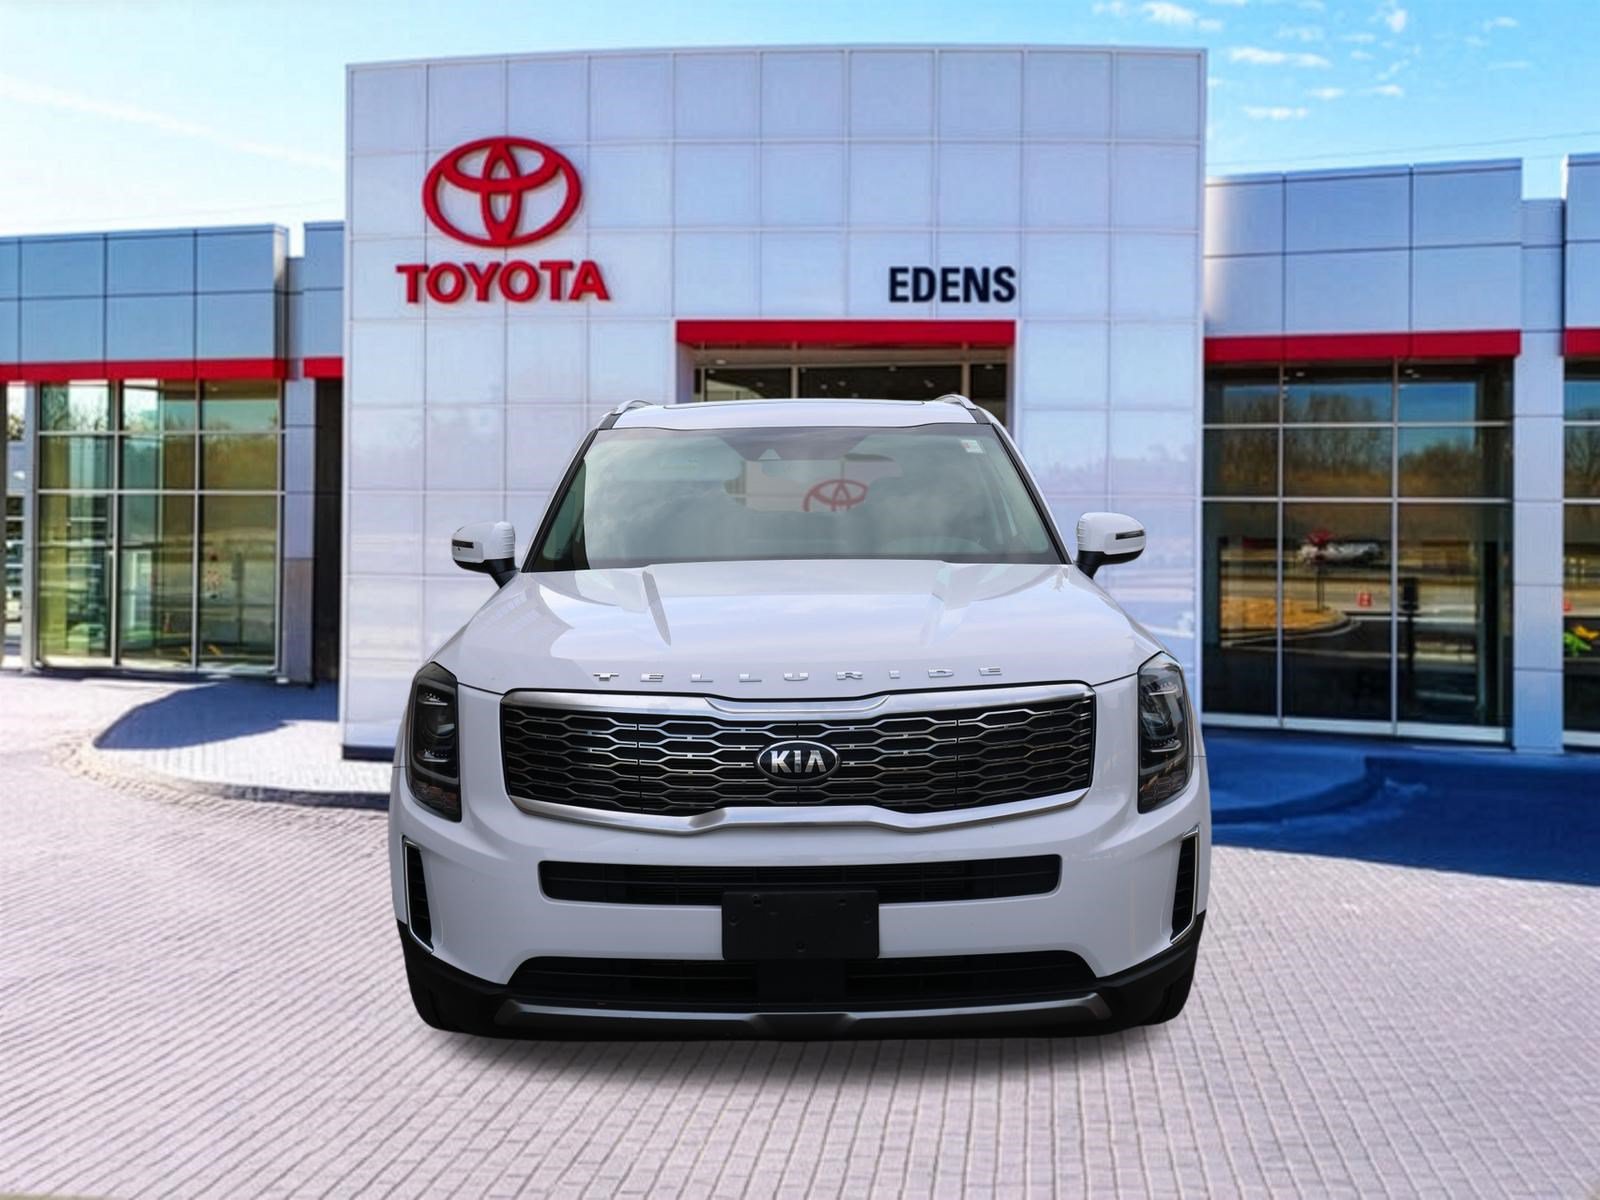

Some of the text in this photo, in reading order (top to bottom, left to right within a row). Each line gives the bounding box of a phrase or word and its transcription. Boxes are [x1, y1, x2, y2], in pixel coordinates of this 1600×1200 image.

[396, 260, 610, 304] TOYOTA
[889, 266, 1016, 303] EDENS
[593, 666, 1003, 682] TELLURIDE
[770, 749, 828, 774] KIA
